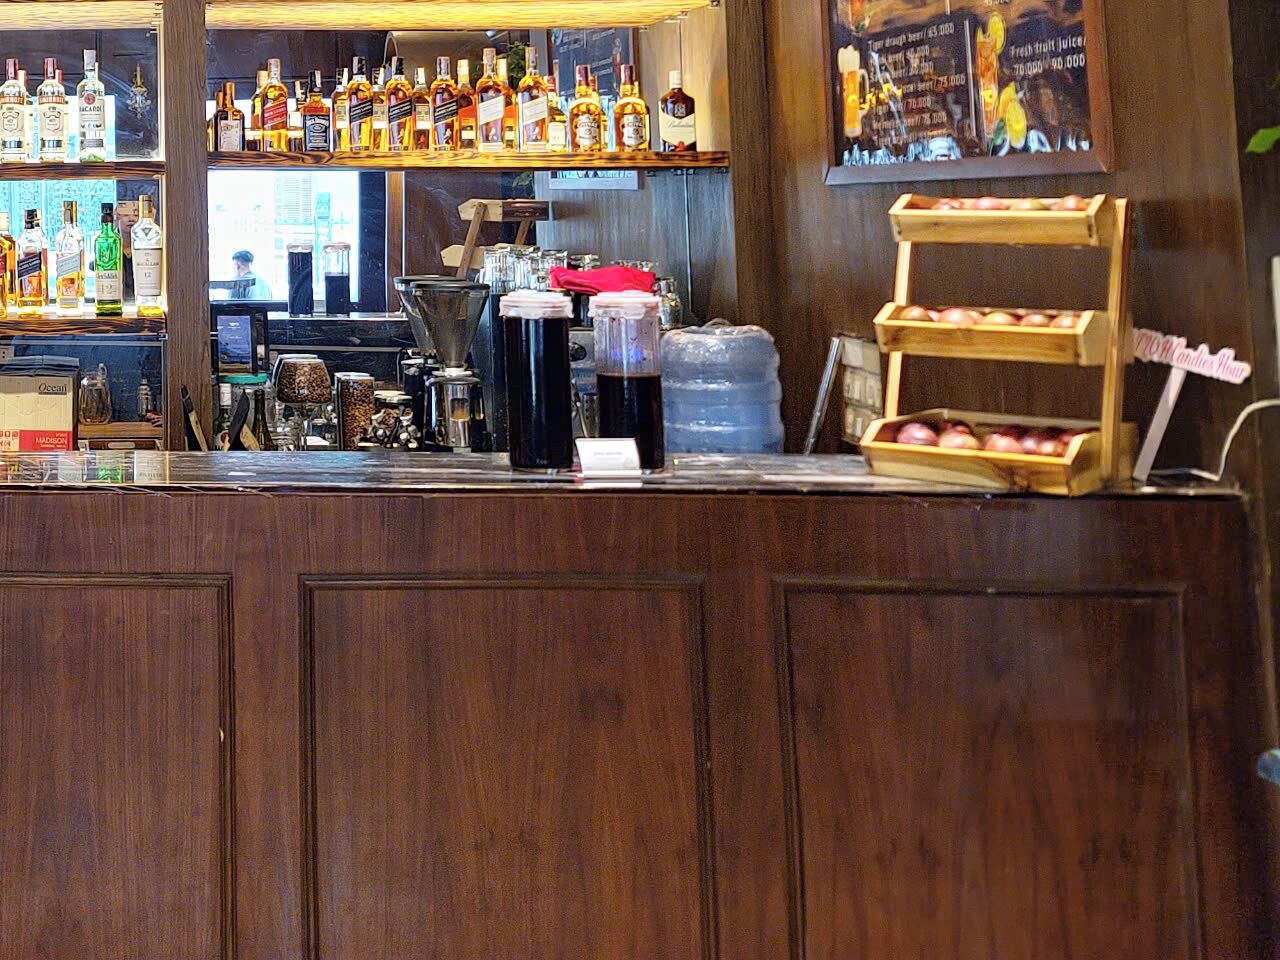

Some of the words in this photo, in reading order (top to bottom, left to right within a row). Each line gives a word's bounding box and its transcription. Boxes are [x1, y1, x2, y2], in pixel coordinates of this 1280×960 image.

[1009, 41, 1033, 59] Fresh
[1033, 37, 1056, 54] fruit
[38, 382, 67, 392] Ocean
